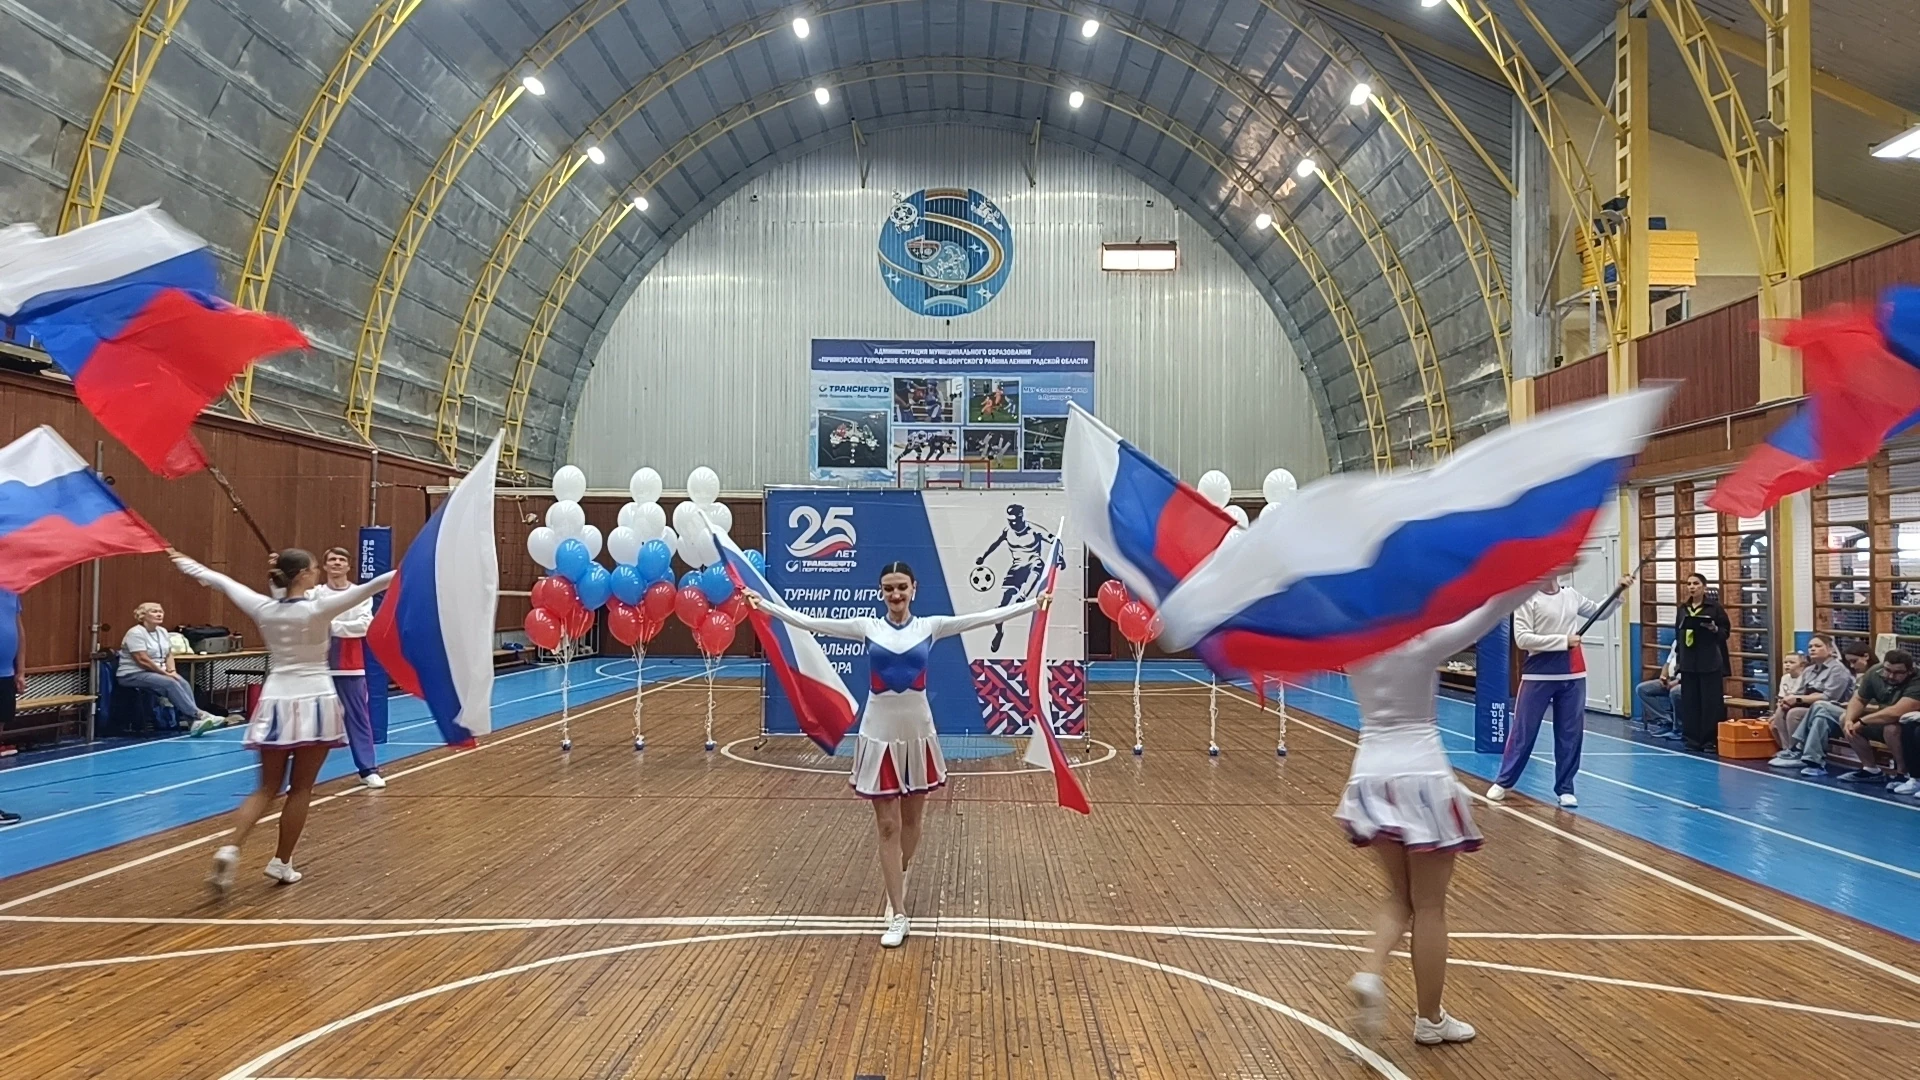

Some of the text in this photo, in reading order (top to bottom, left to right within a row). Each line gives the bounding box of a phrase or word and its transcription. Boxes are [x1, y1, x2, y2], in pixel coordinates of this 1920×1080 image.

[988, 348, 1032, 356] ОБРАЗОВАНИЯ
[938, 357, 983, 365] ВЫБОРГСКОГО
[984, 357, 1008, 365] РАЙОНА
[1008, 357, 1060, 366] ЛЕНИНГРАДСКОЙ
[1060, 357, 1089, 365] ОБЛАСТИ
[829, 385, 890, 393] ТРАНСНЕФТЬ
[788, 505, 857, 551] 25
[834, 549, 858, 558] ЛЕТ
[802, 560, 857, 568] ТРАНСНЕФТЬ
[784, 588, 831, 601] ТУРНИР
[833, 588, 851, 601] ПО
[830, 606, 877, 619] СПОРТА
